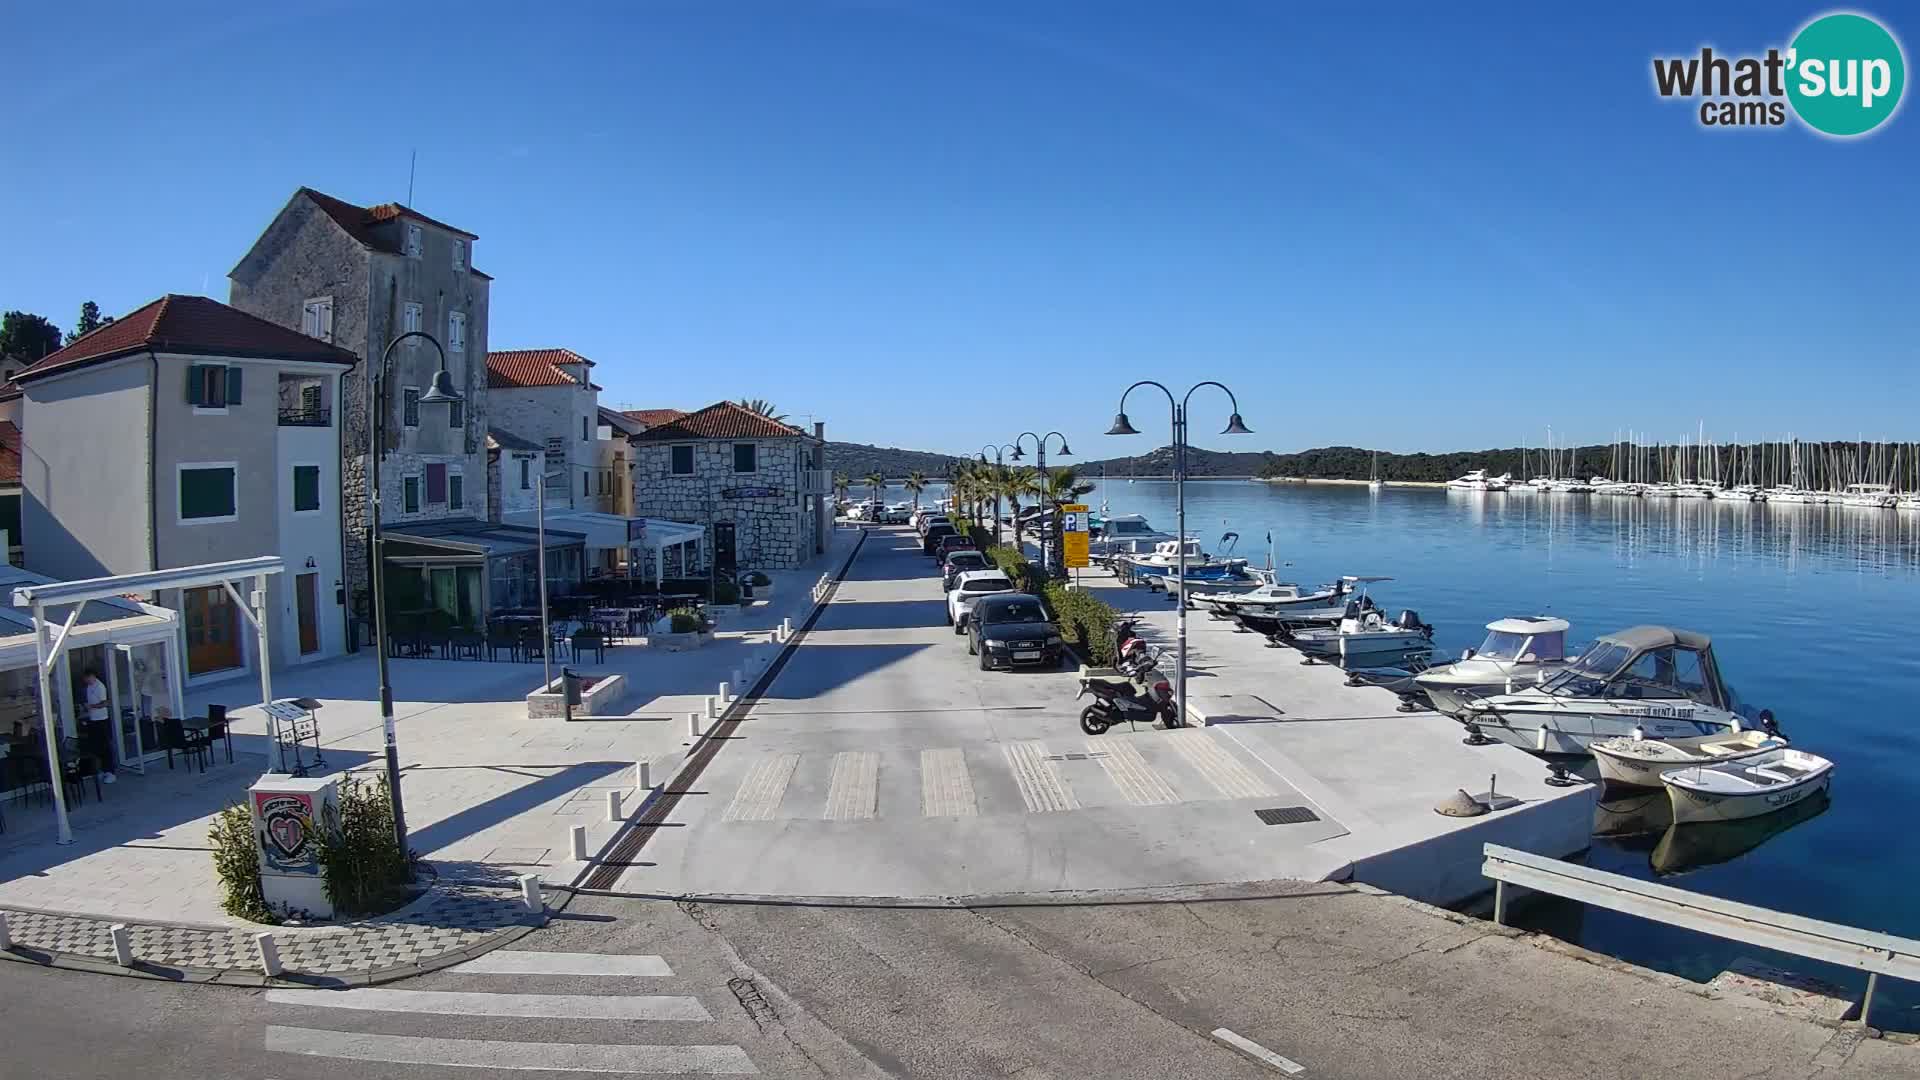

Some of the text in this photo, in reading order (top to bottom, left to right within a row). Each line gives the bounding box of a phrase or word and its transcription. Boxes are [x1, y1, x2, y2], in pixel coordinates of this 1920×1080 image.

[1066, 514, 1076, 530] P
[1652, 707, 1671, 718] RENT
[1677, 708, 1695, 719] BOAT
